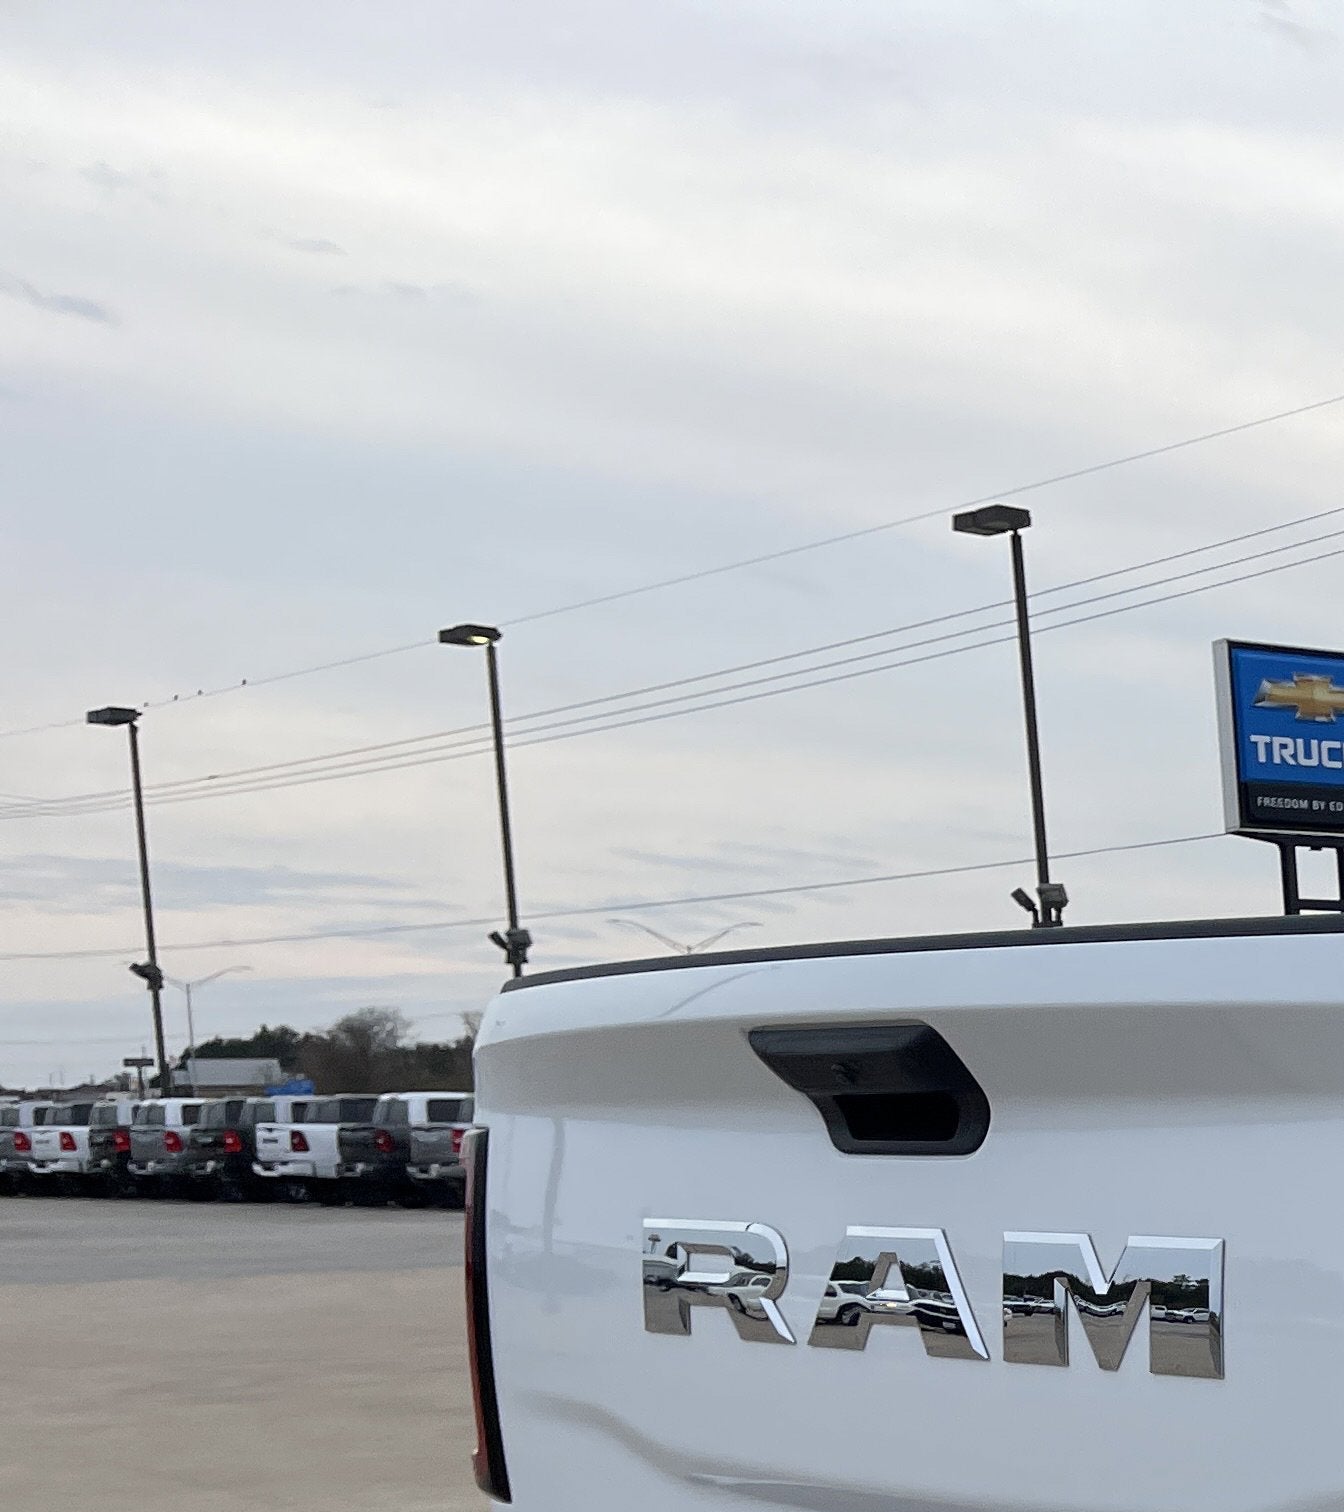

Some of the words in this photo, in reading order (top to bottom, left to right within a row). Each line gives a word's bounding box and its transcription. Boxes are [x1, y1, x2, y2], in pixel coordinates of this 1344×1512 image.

[1256, 796, 1308, 810] FREEDOM
[1312, 800, 1325, 811] BY
[1329, 801, 1343, 812] ED
[643, 1217, 1225, 1380] RAM
